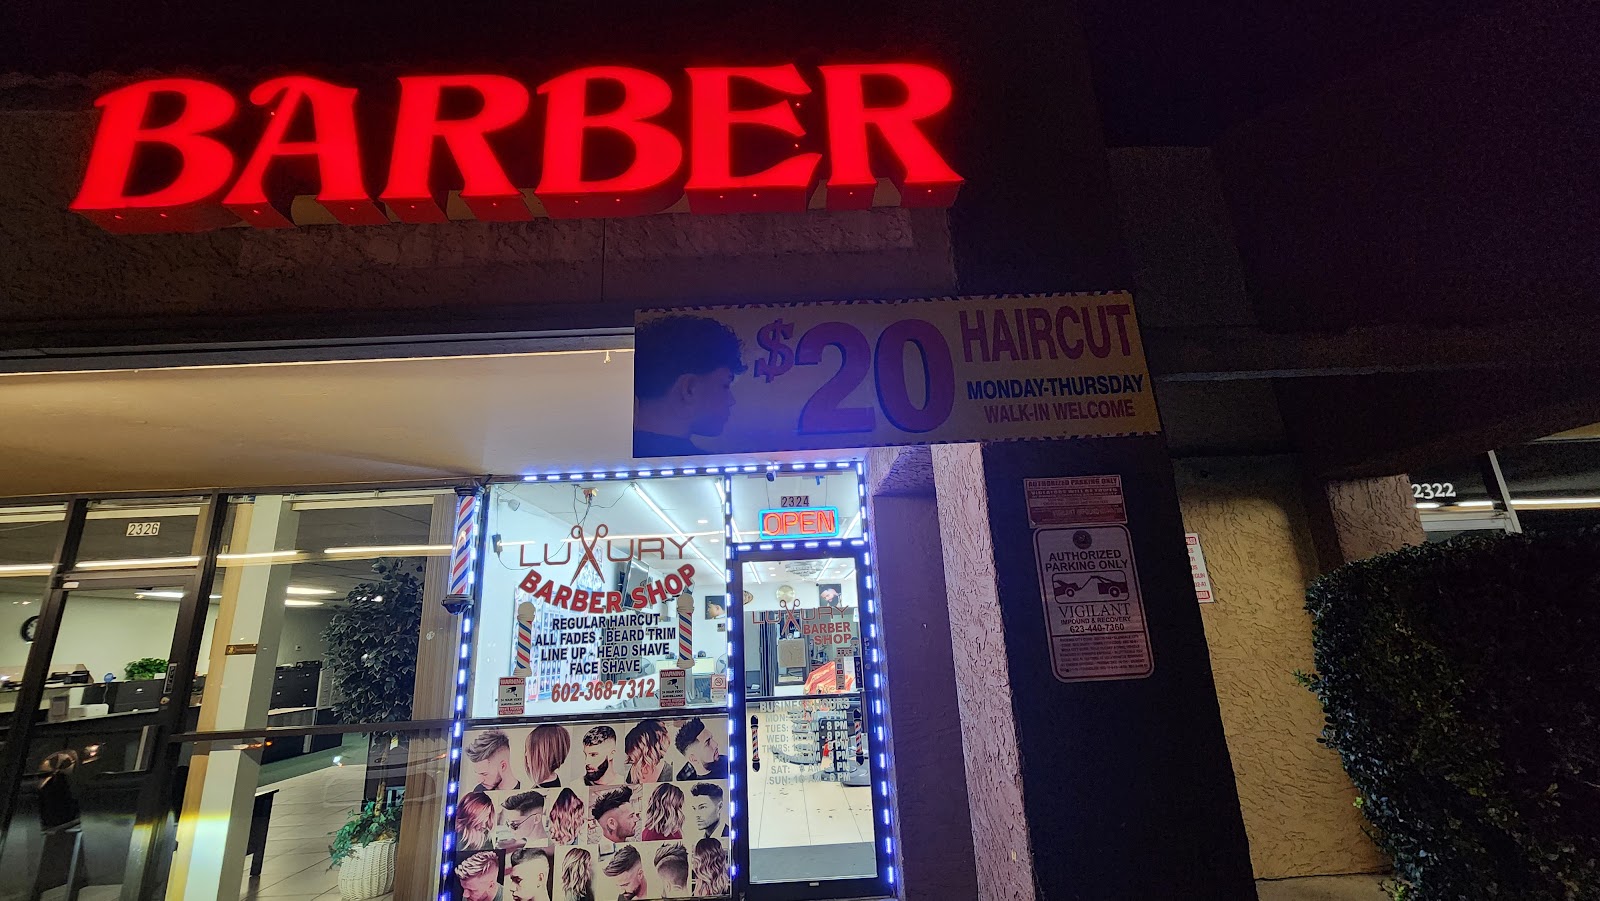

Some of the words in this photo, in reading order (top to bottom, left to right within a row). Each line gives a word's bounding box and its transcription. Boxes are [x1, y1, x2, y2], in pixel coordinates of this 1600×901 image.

[70, 63, 965, 214] BARBER
[959, 304, 1131, 362] HAIRCUT
[753, 318, 955, 435] $20
[967, 374, 1143, 400] MONDAY-THURSDAY
[984, 402, 1050, 424] WALK-IN
[1053, 399, 1136, 421] WELCOME
[1411, 482, 1456, 499] 2322
[781, 495, 810, 507] 2324
[128, 523, 159, 535] 2326
[764, 510, 835, 535] OPEN
[1049, 549, 1121, 561] AUTHORIZED
[1045, 560, 1096, 572] PARKING
[1099, 558, 1128, 570] ONLY
[519, 569, 623, 614] BARBER
[631, 563, 696, 609] SHOP
[1058, 602, 1131, 618] VIGILANT
[552, 616, 606, 630] REGULAR
[609, 613, 661, 628] HAIRCUT
[803, 622, 851, 635] BARBER
[1061, 617, 1090, 625] IMPOUND
[535, 634, 557, 646] ALL
[560, 632, 596, 645] FADES
[606, 629, 644, 643] BEARD
[647, 627, 676, 641] TRIM
[814, 633, 852, 645] SHOP
[541, 648, 568, 660] LINE
[571, 647, 587, 660] UP
[597, 645, 628, 658] HEAD
[632, 642, 670, 657] SHAVE
[570, 661, 598, 675] FACE
[602, 660, 640, 674] SHAVE
[551, 678, 655, 703] 602-368-7312
[765, 724, 789, 733] TUES:
[826, 721, 832, 730] 8
[834, 720, 848, 730] PM
[766, 734, 789, 743] WED:
[826, 731, 833, 740] 8
[835, 730, 848, 740] PM
